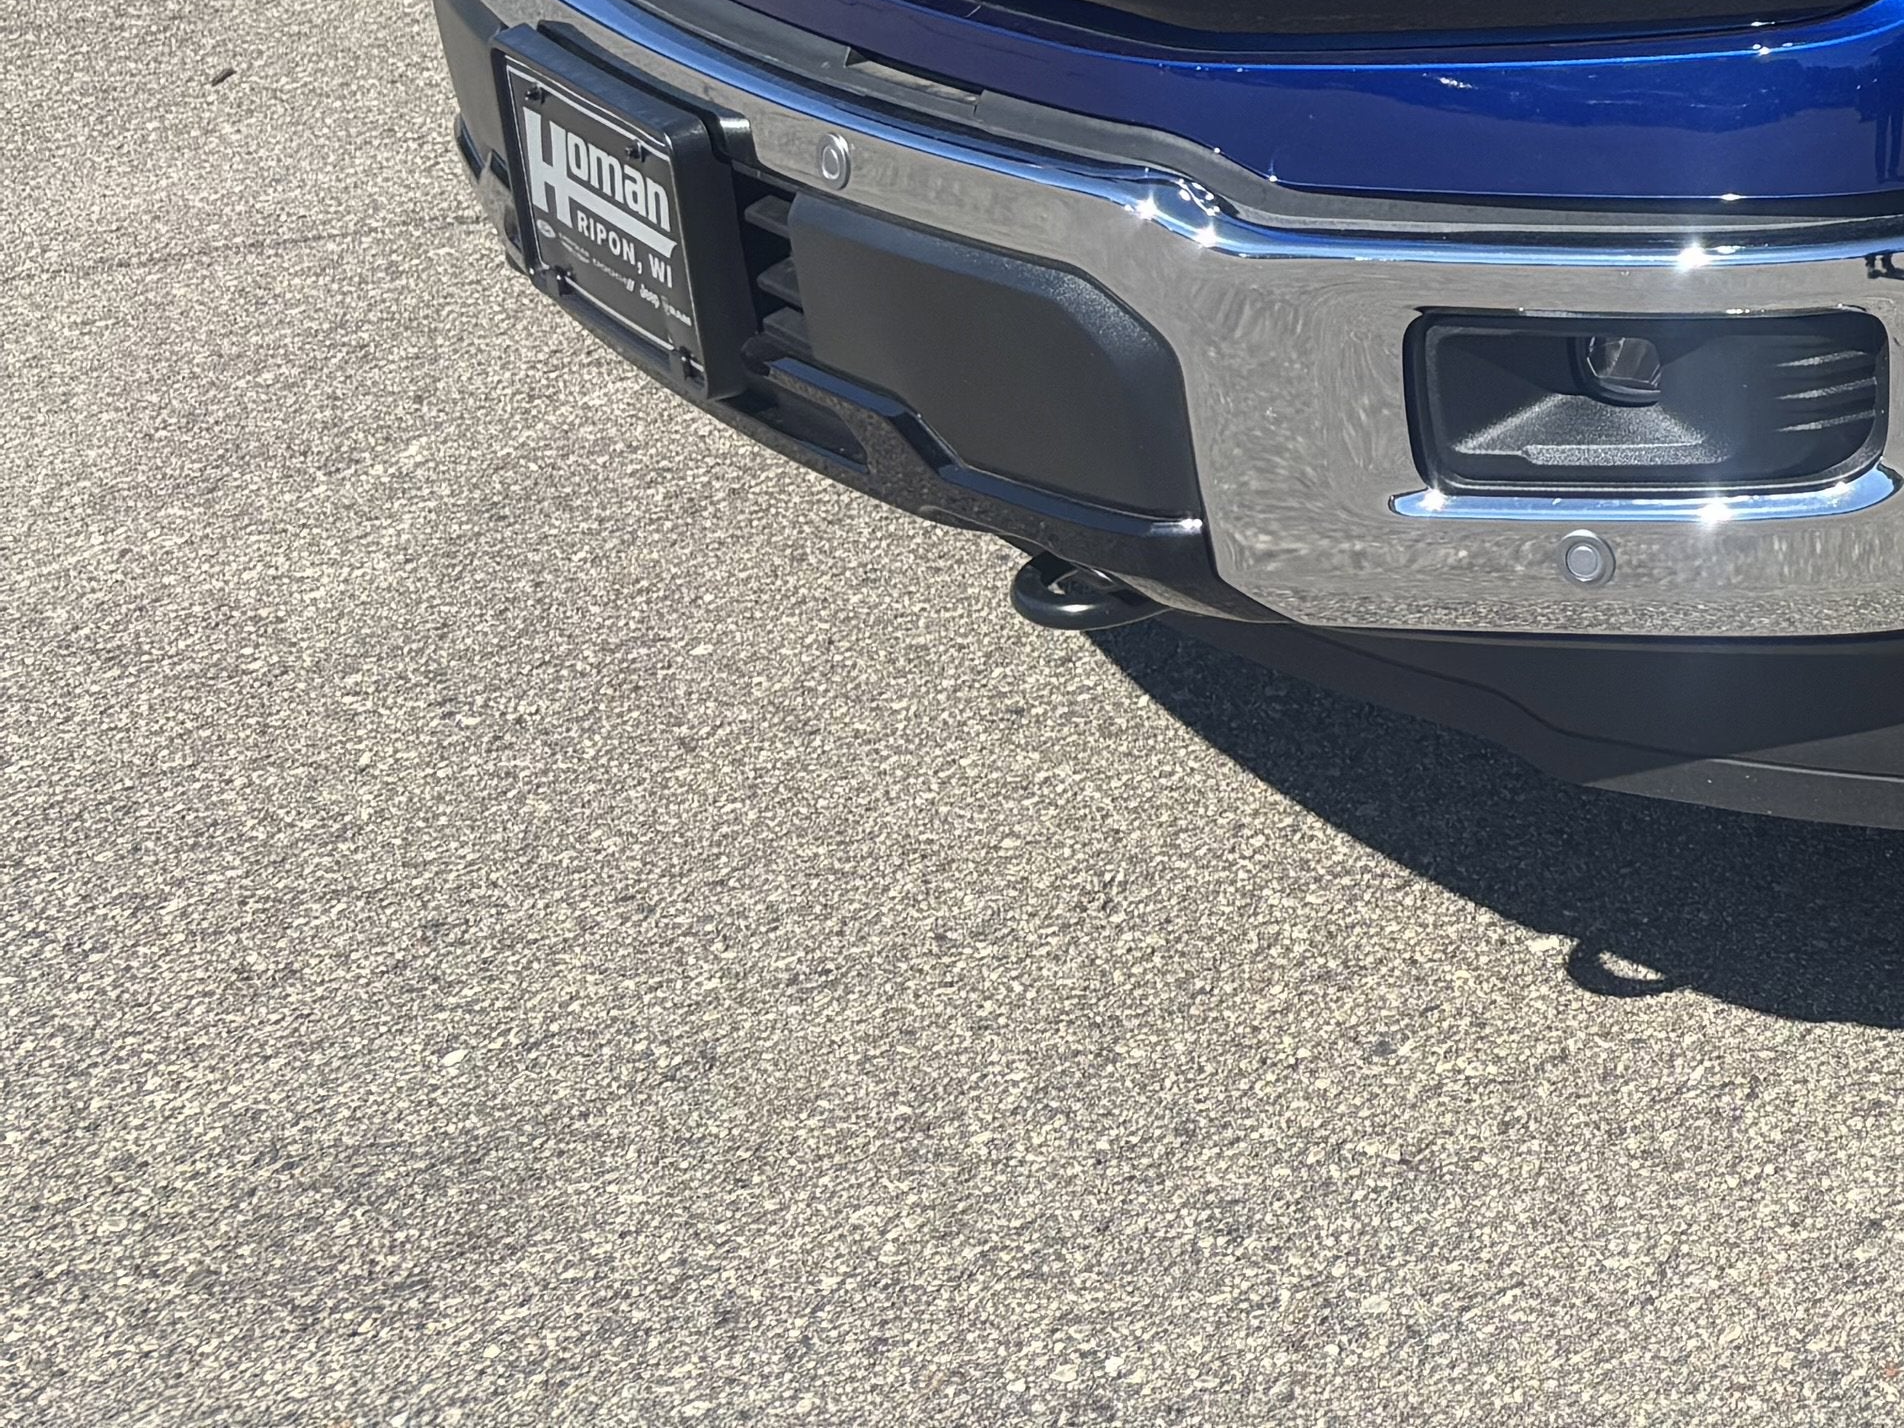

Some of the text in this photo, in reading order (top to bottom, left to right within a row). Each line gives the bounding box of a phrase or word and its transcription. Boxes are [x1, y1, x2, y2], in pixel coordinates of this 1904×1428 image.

[523, 106, 672, 234] Homan
[576, 210, 643, 275] RIPON,
[648, 253, 673, 288] WI
